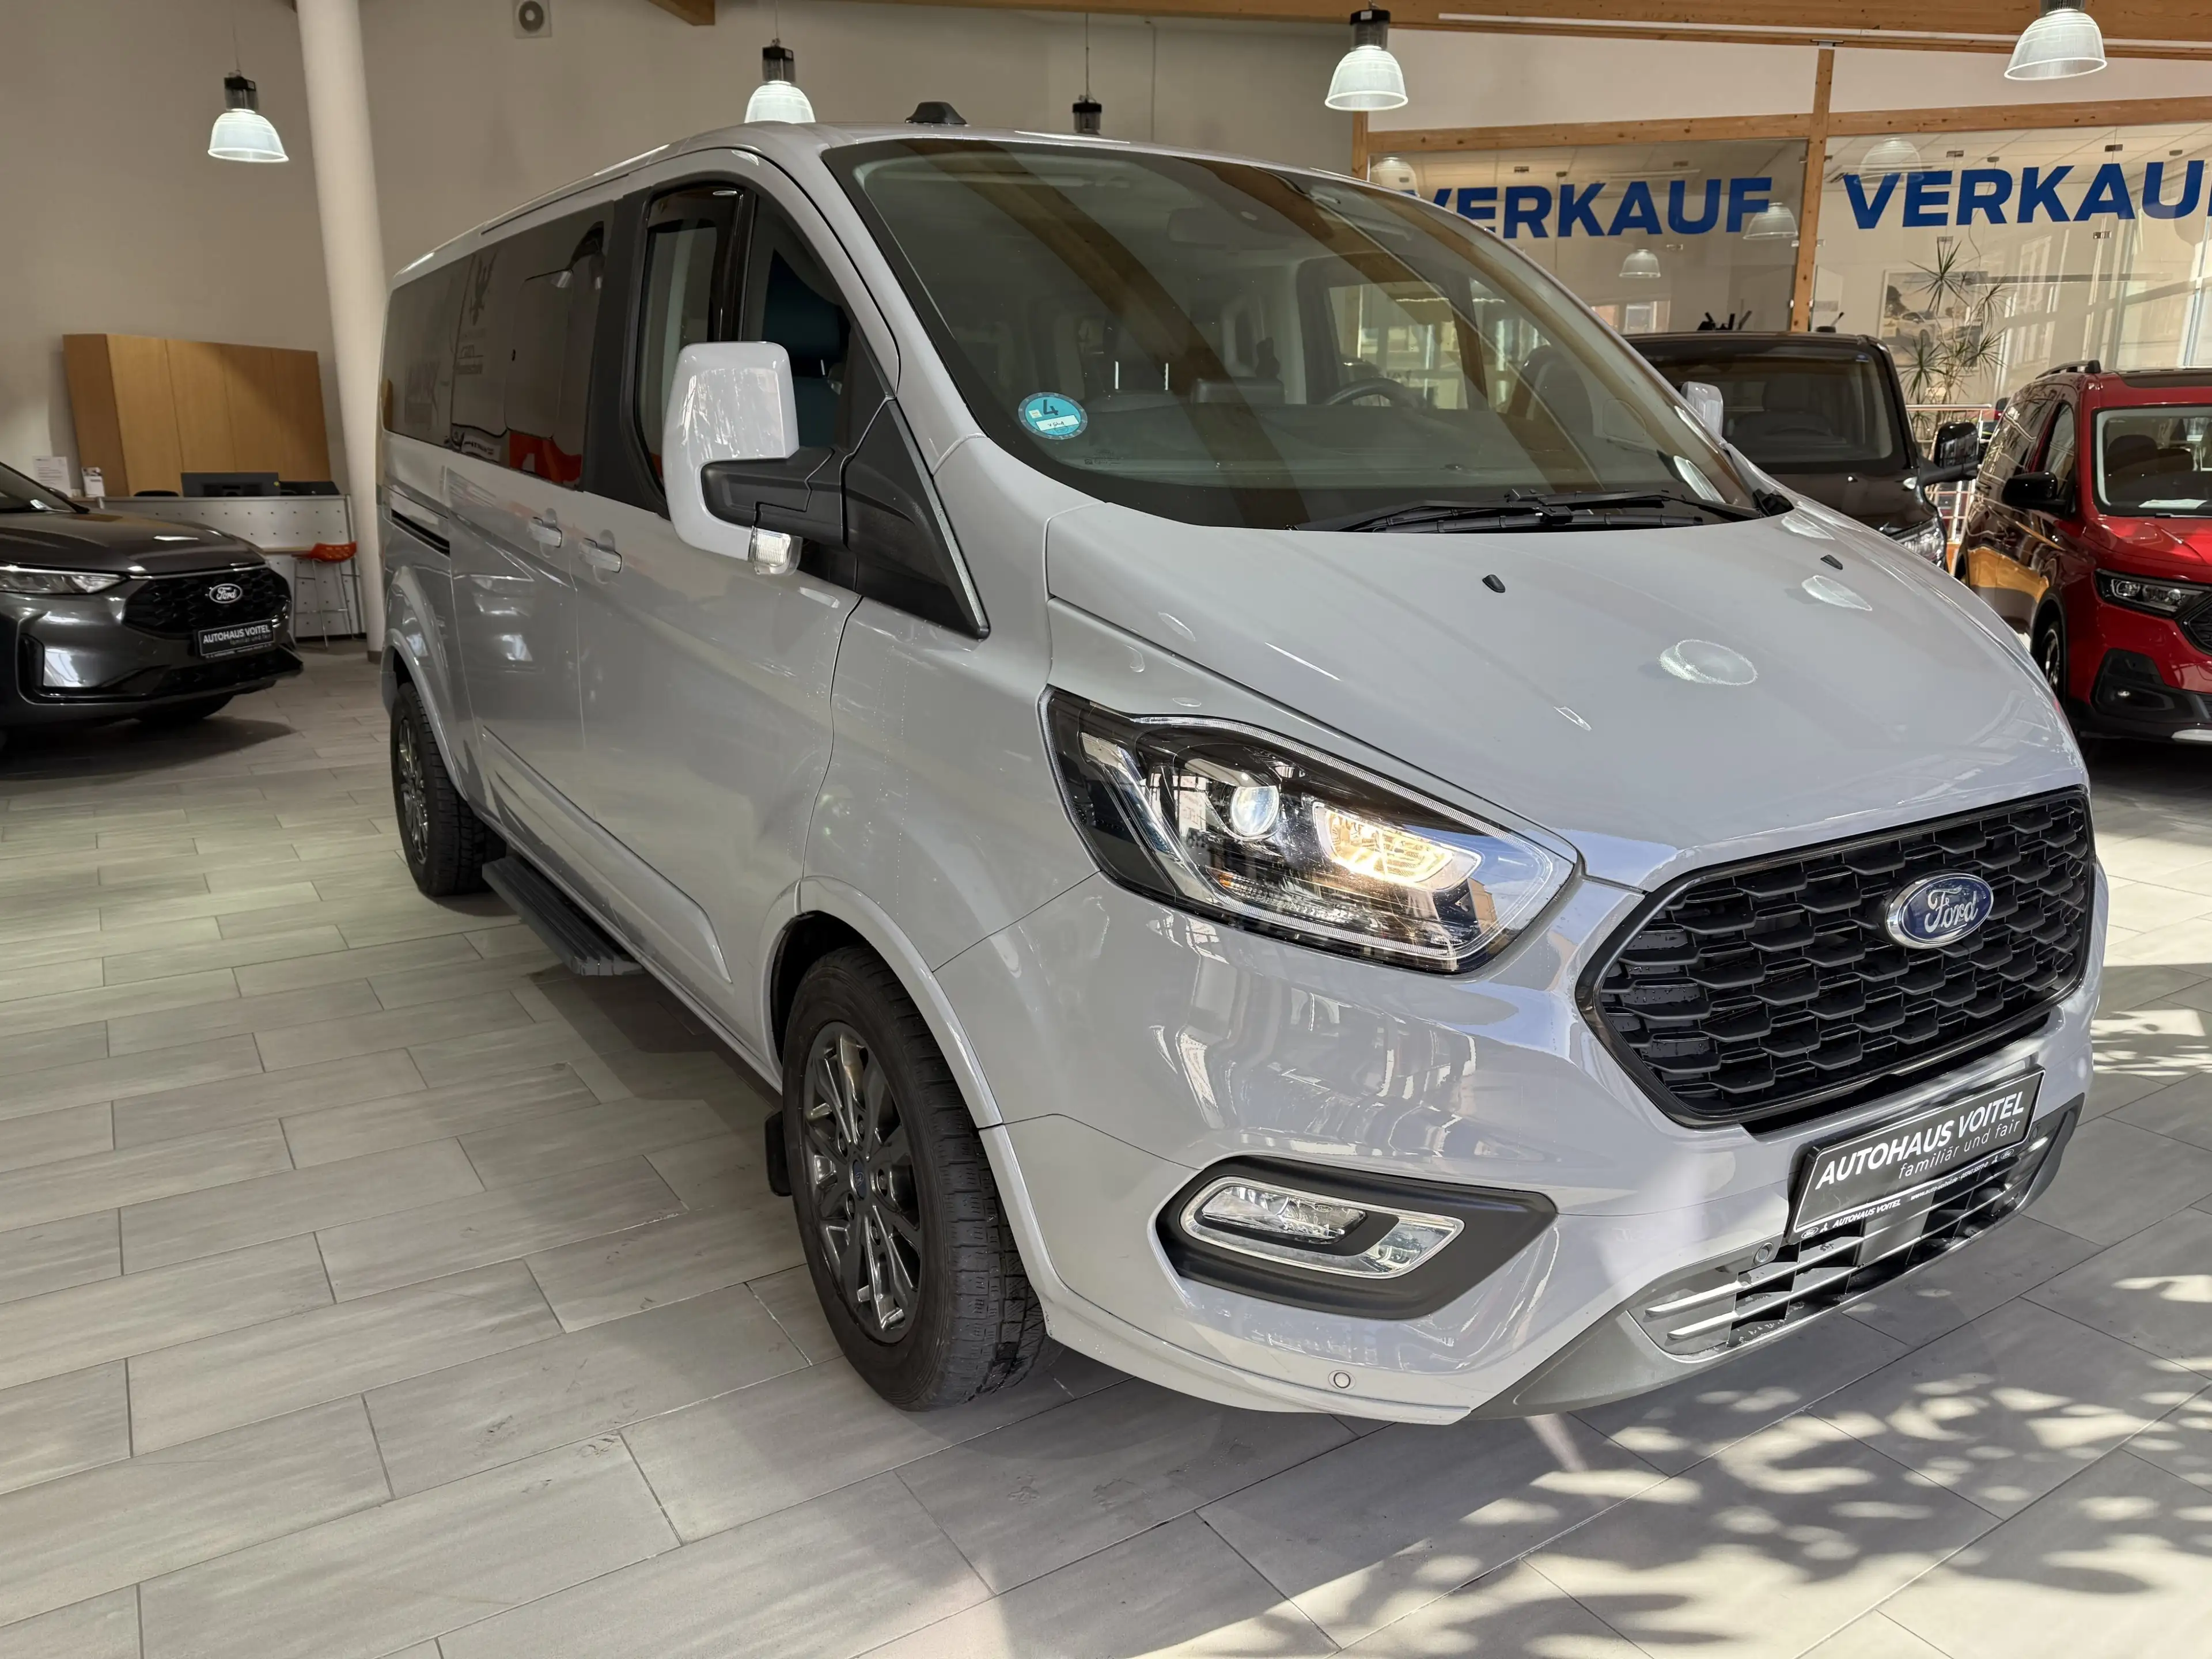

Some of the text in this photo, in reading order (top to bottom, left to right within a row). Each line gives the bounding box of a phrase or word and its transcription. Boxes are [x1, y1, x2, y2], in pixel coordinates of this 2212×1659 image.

[1843, 160, 2212, 229] VERKAU
[1043, 399, 1059, 415] 4
[216, 587, 237, 600] Ford
[203, 628, 244, 644] AUTOHAUS
[244, 624, 271, 638] VOITEL
[1925, 885, 1978, 933] Ford
[1815, 1091, 2024, 1190] AUTOHAUS VOITEL
[1899, 1119, 2020, 1179] familiär und fair
[1832, 1207, 1876, 1228] AUTOHAUS
[1876, 1199, 1901, 1214] VOITEL
